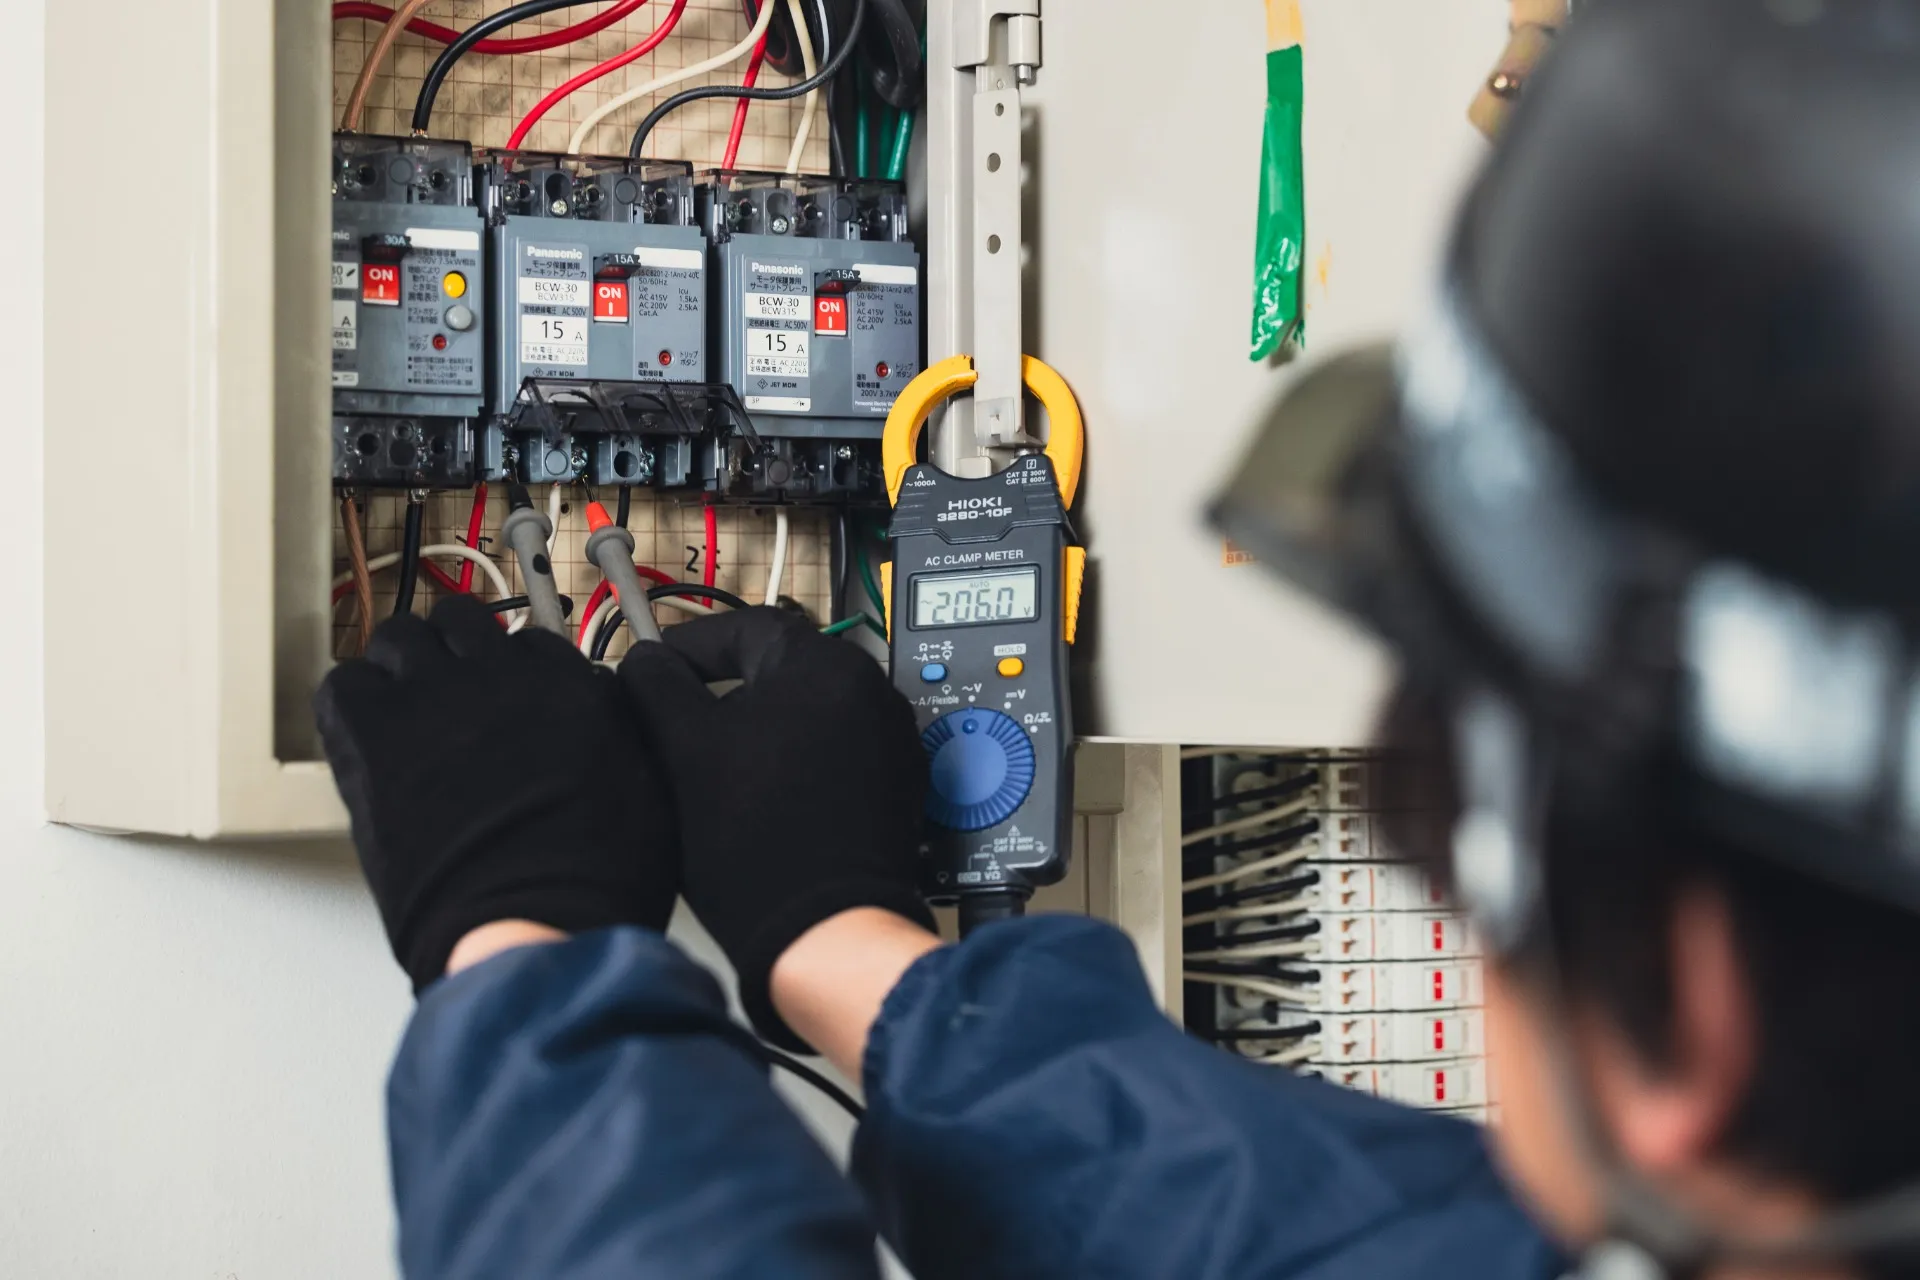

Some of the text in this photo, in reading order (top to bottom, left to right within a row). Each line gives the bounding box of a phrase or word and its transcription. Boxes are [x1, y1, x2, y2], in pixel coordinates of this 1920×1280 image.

[526, 245, 583, 260] Panasonic
[613, 253, 635, 264] 15A
[368, 268, 394, 282] ON
[751, 262, 804, 276] Panasonic
[836, 269, 855, 279] 15A
[535, 281, 578, 293] BCW-30
[598, 286, 622, 299] ON
[759, 296, 800, 307] BCW-30
[819, 301, 841, 313] ON
[761, 306, 797, 316] BCW315
[541, 320, 583, 341] 15 A
[765, 333, 805, 354] 15 A
[1006, 471, 1020, 479] CAT
[948, 497, 1002, 510] HIOKI
[937, 507, 1012, 522] 3280-10F
[925, 549, 1024, 566] AC CLAMP METER
